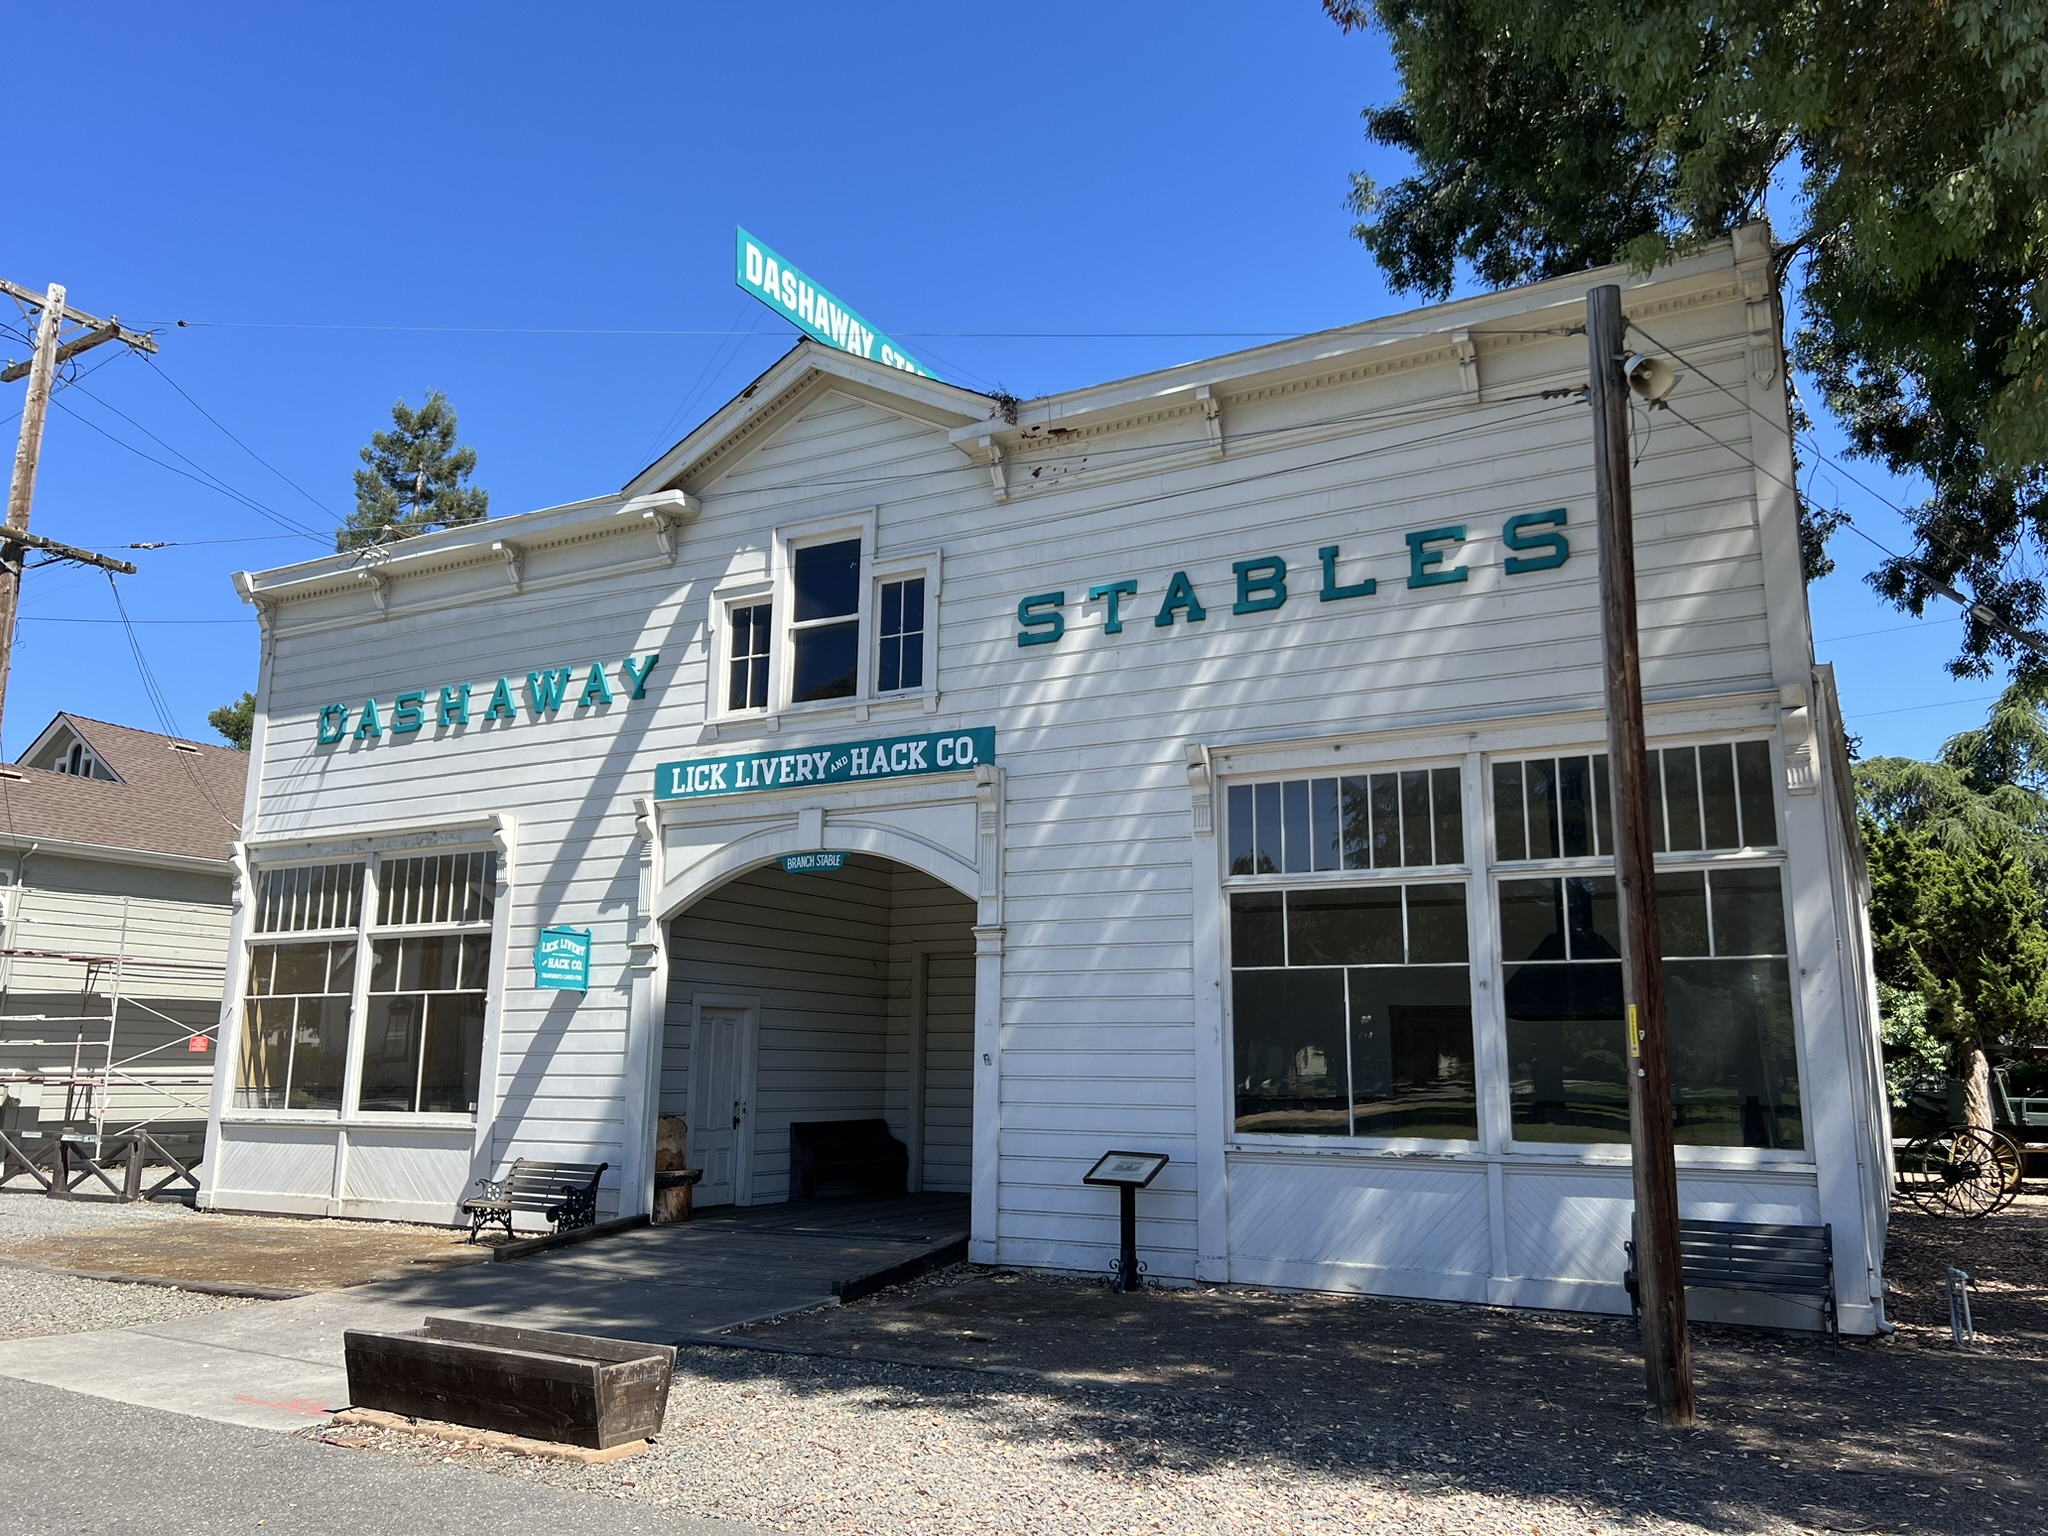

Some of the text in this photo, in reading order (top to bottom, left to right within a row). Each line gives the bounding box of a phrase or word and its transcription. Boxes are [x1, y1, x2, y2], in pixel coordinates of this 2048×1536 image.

[746, 241, 874, 359] DASHAWAY
[317, 507, 1570, 745] DASHAWAY STABLES
[671, 736, 979, 795] LICK LIVERY AND HACK CO.
[787, 854, 841, 870] BRANCH STABLE
[541, 938, 586, 956] LICK LIVERY
[547, 957, 570, 970] HACK
[571, 959, 584, 971] CO.
